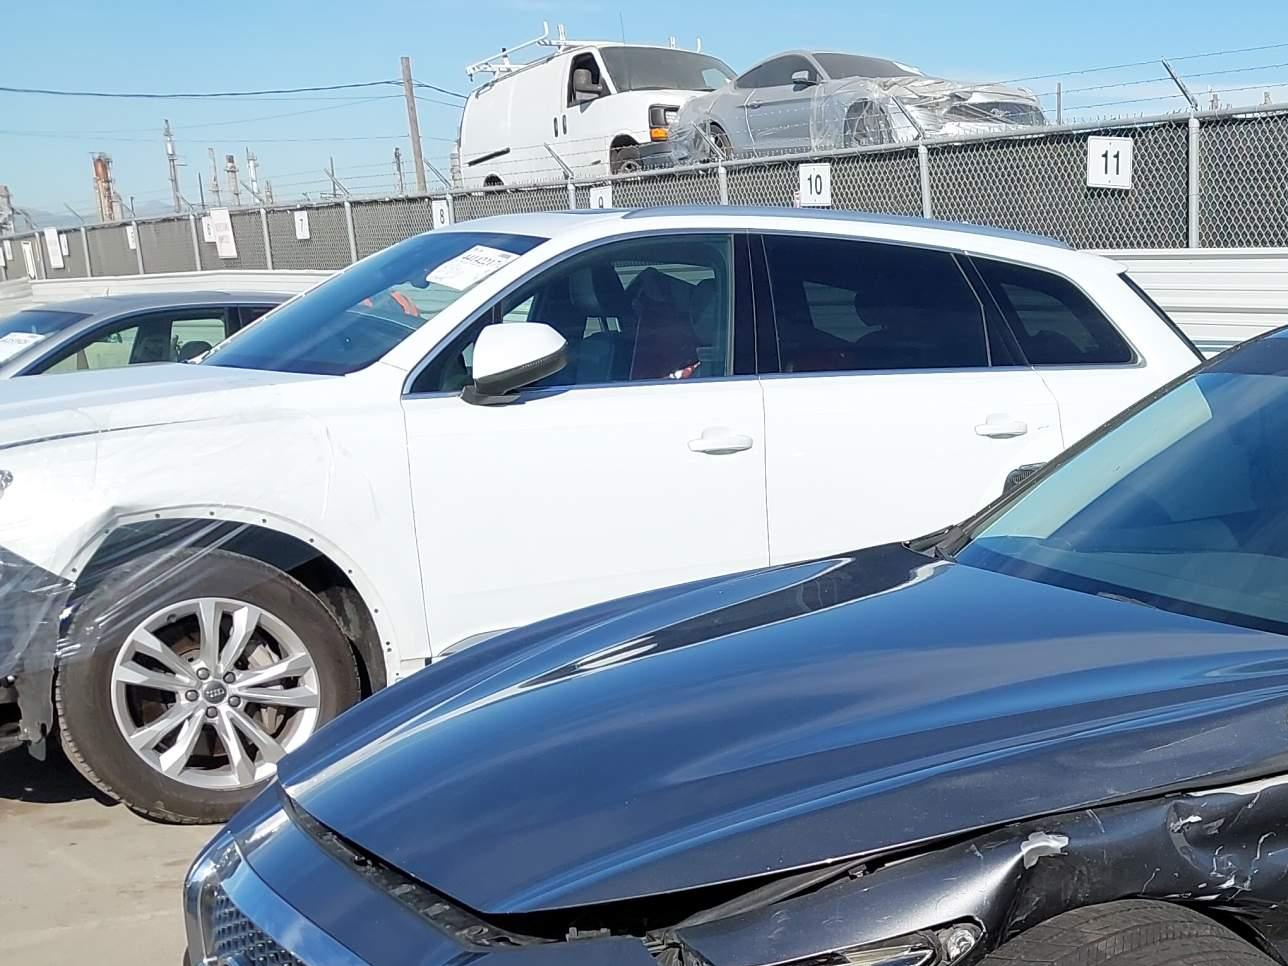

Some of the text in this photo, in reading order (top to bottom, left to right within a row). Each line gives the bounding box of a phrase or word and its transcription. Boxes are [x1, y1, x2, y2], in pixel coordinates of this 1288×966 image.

[1101, 149, 1121, 176] 11
[808, 174, 822, 195] 10
[439, 208, 445, 224] 8
